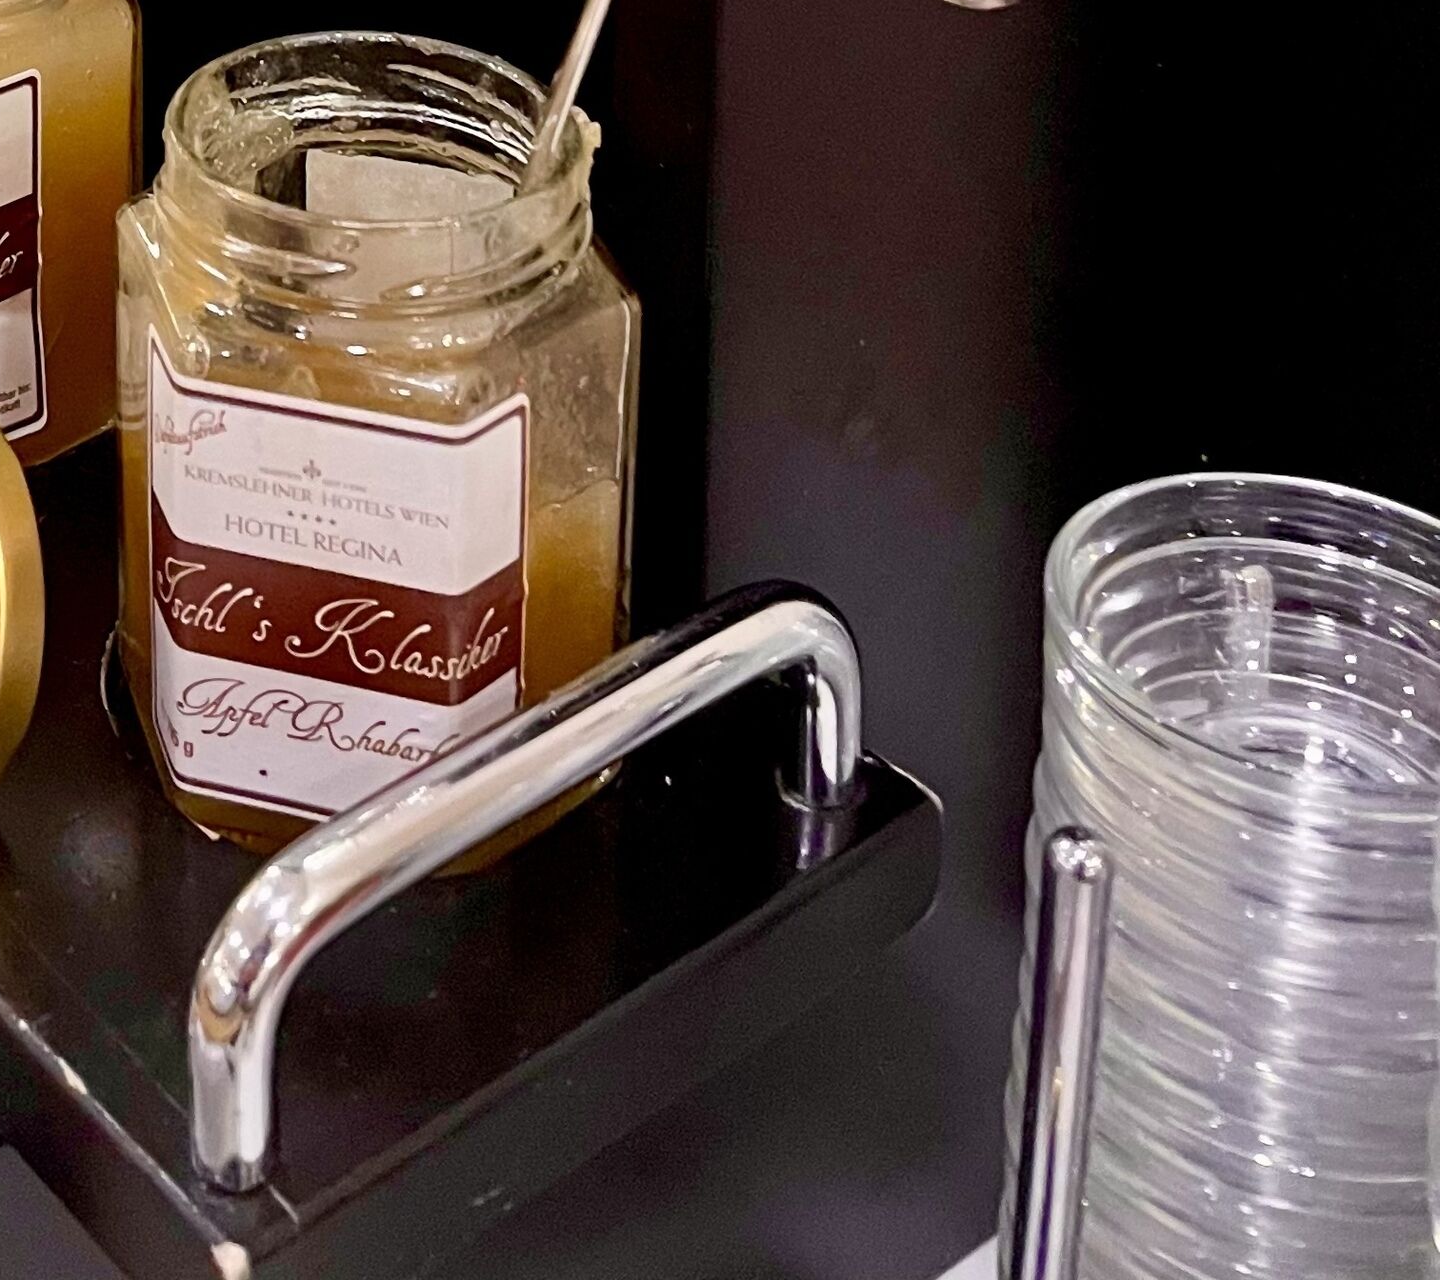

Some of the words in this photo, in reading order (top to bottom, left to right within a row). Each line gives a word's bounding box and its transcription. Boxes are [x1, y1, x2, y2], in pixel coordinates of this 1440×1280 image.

[184, 463, 312, 503] KREMSLEHNER
[322, 493, 394, 521] HOTELS
[399, 507, 449, 530] WIEN
[224, 513, 307, 549] HOTEL
[313, 531, 403, 567] REGINA
[284, 598, 509, 681] Klassiker
[176, 677, 306, 737] Apfel
